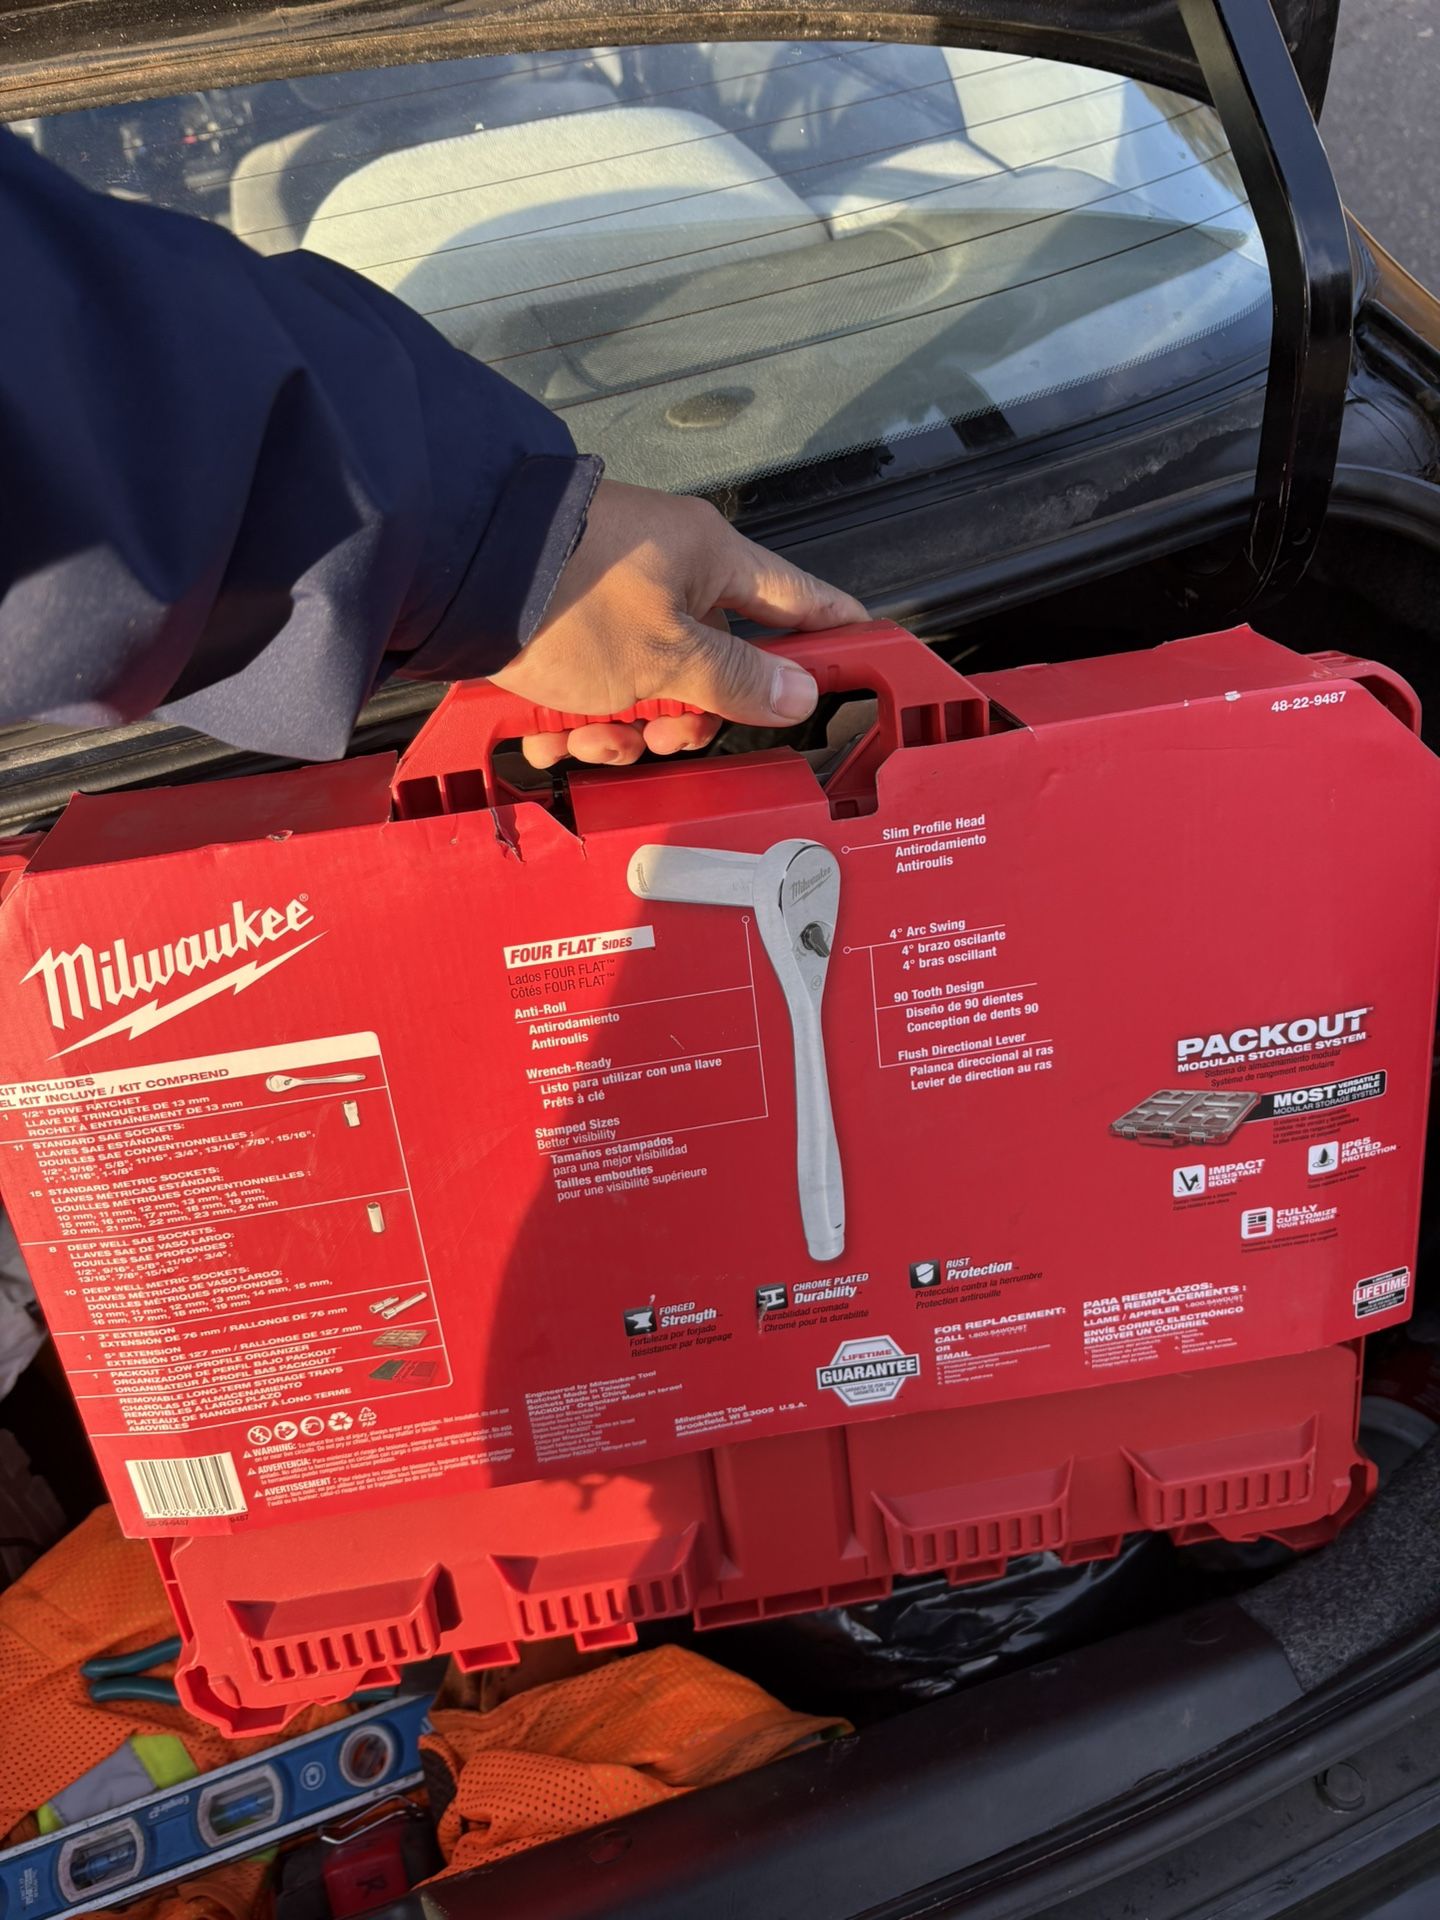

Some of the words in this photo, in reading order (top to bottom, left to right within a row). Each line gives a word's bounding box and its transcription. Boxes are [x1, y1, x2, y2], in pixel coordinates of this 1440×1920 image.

[1271, 690, 1347, 712] 48-22-9487
[882, 825, 909, 840] Slim
[913, 818, 952, 835] Profile
[955, 813, 985, 828] Head
[895, 833, 987, 857] Antirodamiento
[896, 854, 954, 873] Antiroulis
[889, 927, 903, 939] 4°
[906, 923, 926, 937] Arc
[929, 918, 966, 935] Swing
[509, 943, 553, 964] FOUR
[601, 935, 633, 950] SIDES
[902, 943, 914, 956] 4°
[918, 938, 951, 953] brazo
[953, 930, 1006, 947] oscilante
[19, 897, 314, 1030] Milwaukee
[903, 959, 915, 971] 4°
[919, 954, 944, 968] bras
[948, 946, 997, 964] oscillant
[508, 970, 542, 986] Lados
[544, 964, 575, 980] FOUR
[511, 984, 541, 1000] Côtés
[544, 978, 575, 994] FOUR
[894, 990, 908, 1002] 90
[912, 985, 942, 1000] Tooth
[946, 978, 985, 996] Design
[514, 1001, 567, 1019] Anti-Roll
[906, 1002, 944, 1018] Diseño
[948, 1000, 962, 1011] de
[964, 997, 979, 1009] 90
[982, 990, 1024, 1006] dientes
[529, 1010, 620, 1035] Antirodamiento
[907, 1013, 970, 1034] Conception
[973, 1010, 987, 1022] de
[990, 1005, 1021, 1020] dents
[1024, 1002, 1039, 1014] 90
[531, 1031, 589, 1050] Antiroulis
[1177, 1007, 1367, 1061] PACKOUT
[898, 1046, 928, 1061] Flush
[932, 1036, 992, 1055] Directional
[996, 1032, 1026, 1045] Lever
[1178, 1052, 1245, 1073] MODULAR
[1248, 1041, 1311, 1062] STORAGE
[1315, 1031, 1366, 1049] SYSTEM
[526, 1056, 612, 1081] Wrench-Ready
[910, 1060, 954, 1076] Palanca
[957, 1049, 1019, 1069] direccional
[1022, 1047, 1032, 1058] al
[1036, 1044, 1054, 1056] ras
[21, 1075, 95, 1096] INCLUDES
[541, 1080, 569, 1095] Listo
[573, 1077, 599, 1091] para
[602, 1068, 643, 1085] utilizar
[647, 1066, 667, 1077] con
[671, 1061, 691, 1073] una
[695, 1056, 722, 1070] llave
[911, 1075, 945, 1090] Levier
[948, 1073, 962, 1084] de
[965, 1064, 1014, 1082] direction
[1018, 1063, 1031, 1073] au
[1034, 1059, 1052, 1070] ras
[19, 1094, 42, 1107] KIT
[45, 1085, 108, 1104] INCLUYE
[109, 1084, 116, 1094] /
[119, 1080, 142, 1093] KIT
[146, 1067, 229, 1088] COMPREND
[543, 1094, 574, 1109] Prêts
[577, 1092, 584, 1103] à
[587, 1089, 606, 1102] clé
[1273, 1084, 1337, 1108] MOST
[1337, 1073, 1380, 1088] VERSATILE
[1338, 1080, 1380, 1096] DURABLE
[3, 1113, 9, 1121] 1
[22, 1109, 45, 1121] 1/2"
[48, 1103, 83, 1117] DRIVE
[86, 1095, 141, 1111] RATCHET
[26, 1116, 61, 1130] LLAVE
[64, 1114, 79, 1124] DE
[81, 1103, 150, 1122] TRINQUETE
[153, 1100, 169, 1111] DE
[171, 1097, 185, 1108] 13
[188, 1094, 210, 1105] mm
[1273, 1101, 1313, 1116] MODULAR
[1315, 1094, 1350, 1109] STORAGE
[1351, 1087, 1380, 1101] SYSTEM
[14, 1144, 24, 1152] 11
[33, 1134, 95, 1152] STANDARD
[98, 1130, 122, 1142] SAE
[124, 1121, 185, 1138] SOCKETS:
[535, 1120, 586, 1140] Stamped
[589, 1115, 620, 1130] Sizes
[537, 1135, 569, 1150] Better
[572, 1127, 616, 1146] visibility
[551, 1146, 602, 1165] Tamaños
[605, 1135, 674, 1156] estampados
[1342, 1136, 1371, 1149] IP65
[1342, 1141, 1381, 1157] RATED
[1342, 1144, 1397, 1163] PROTECTION
[553, 1163, 577, 1176] para
[580, 1159, 599, 1171] una
[603, 1153, 632, 1168] mejor
[635, 1143, 688, 1161] visibilidad
[1209, 1158, 1265, 1175] IMPACT
[556, 1174, 592, 1189] Tailles
[594, 1164, 654, 1183] embouties
[557, 1188, 581, 1202] pour
[584, 1184, 604, 1196] une
[606, 1175, 649, 1192] visibilité
[652, 1166, 708, 1185] supérieure
[1209, 1166, 1261, 1181] RESISTANT
[1209, 1175, 1237, 1187] BODY
[1277, 1203, 1318, 1218] FULLY
[1277, 1207, 1337, 1224] CUSTOMIZE
[946, 1257, 968, 1269] RUST
[947, 1260, 1012, 1281] Protection
[793, 1278, 831, 1292] CHROME
[834, 1272, 868, 1285] PLATED
[1356, 1275, 1408, 1301] LIFETIME
[795, 1284, 857, 1306] Durability
[1082, 1296, 1119, 1310] PARA
[1121, 1282, 1214, 1304] REEMPLAZOS:
[1083, 1303, 1120, 1317] POUR
[1125, 1285, 1238, 1310] REMPLACEMENTS
[659, 1301, 695, 1315] FORGED
[661, 1307, 717, 1328] Strength
[1084, 1314, 1119, 1327] LLAME
[1122, 1313, 1126, 1321] /
[1130, 1304, 1179, 1319] APPELER
[98, 1331, 110, 1341] 3"
[113, 1323, 176, 1342] EXTENSION
[934, 1323, 961, 1335] FOR
[965, 1306, 1066, 1330] REPLACEMENT:
[1084, 1324, 1115, 1337] ENVÍE
[1119, 1317, 1164, 1331] CORREO
[1167, 1304, 1243, 1323] ELECTRÓNICO
[1084, 1329, 1133, 1345] ENVOYER
[1137, 1326, 1152, 1335] UN
[1155, 1318, 1208, 1333] COURRIEL
[935, 1333, 964, 1344] CALL
[936, 1344, 950, 1353] OR
[842, 1349, 893, 1361] LIFETIME
[936, 1349, 971, 1361] EMAIL
[821, 1358, 917, 1385] GUARANTEE
[252, 1442, 297, 1457] WARNING:
[257, 1457, 312, 1474] ADVERTENCIA:
